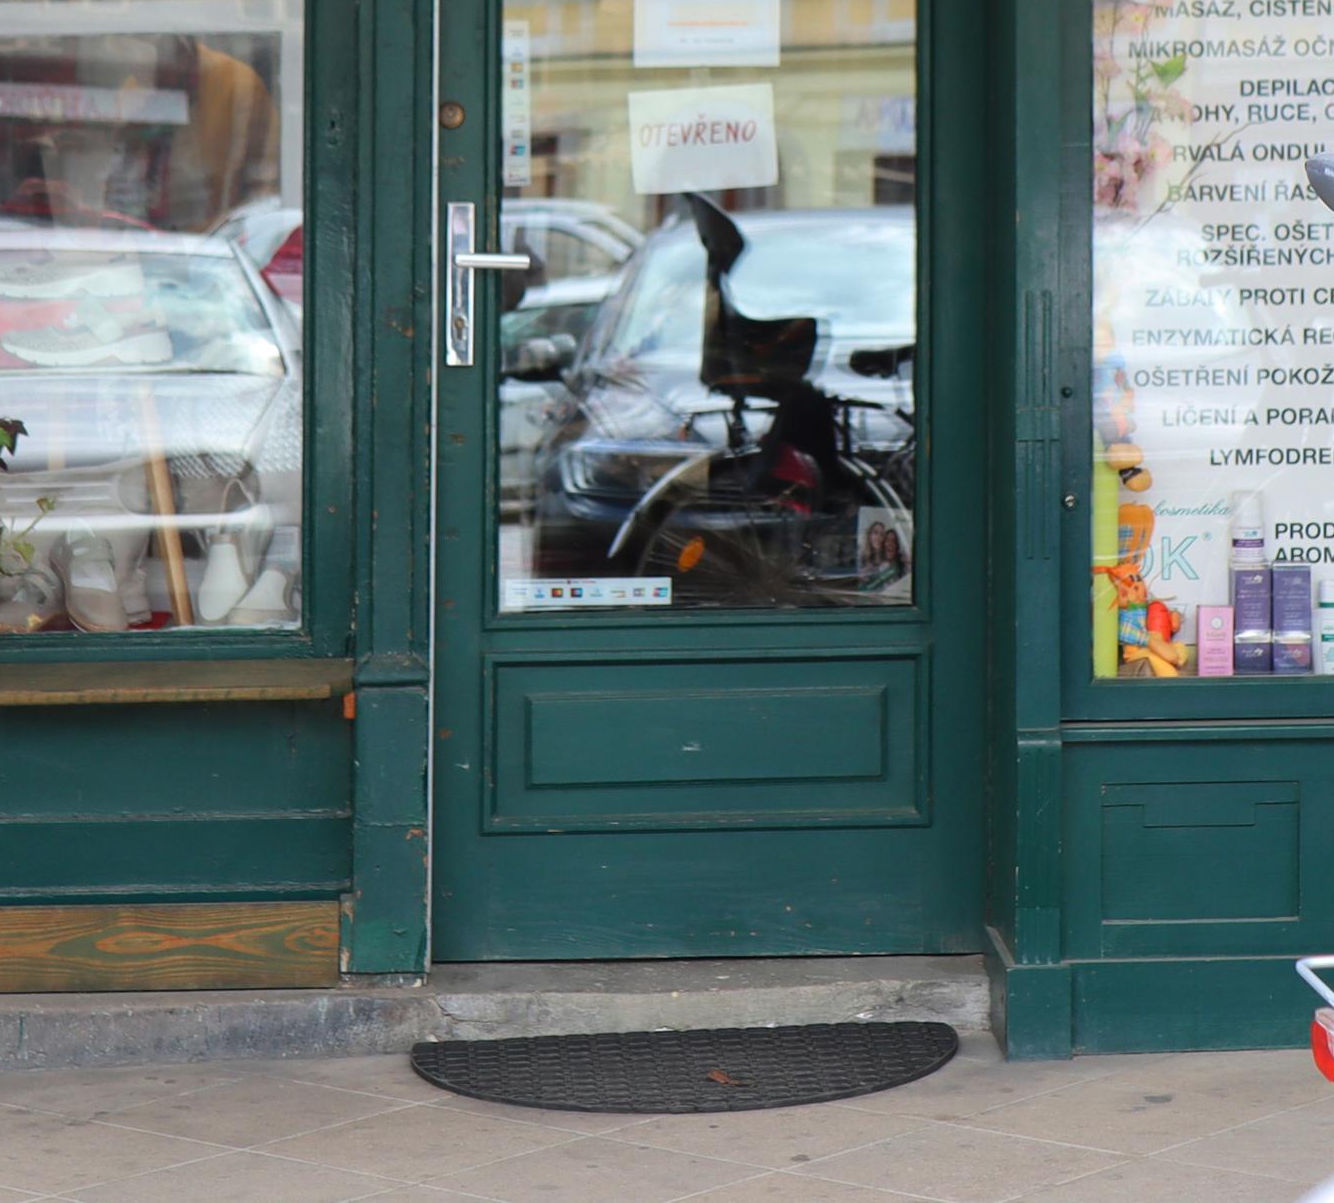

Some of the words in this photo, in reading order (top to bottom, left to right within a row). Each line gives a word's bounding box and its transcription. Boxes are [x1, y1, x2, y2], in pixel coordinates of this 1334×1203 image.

[1128, 37, 1287, 59] MIKROMASÁŽ
[1248, 103, 1317, 124] RUCE,
[639, 115, 758, 149] OTEVŘENO
[1173, 139, 1246, 163] RVALÁ
[1169, 179, 1267, 203] BARVENÍ
[1275, 180, 1318, 202] ŘAS
[1201, 224, 1267, 243] SPEC.
[1239, 288, 1306, 306] PROTI
[1132, 325, 1295, 347] ENZYMATICKÁ
[1134, 365, 1251, 387] OŠETŘENÍ
[1162, 405, 1238, 428] LÍČENÍ
[1244, 409, 1259, 426] A
